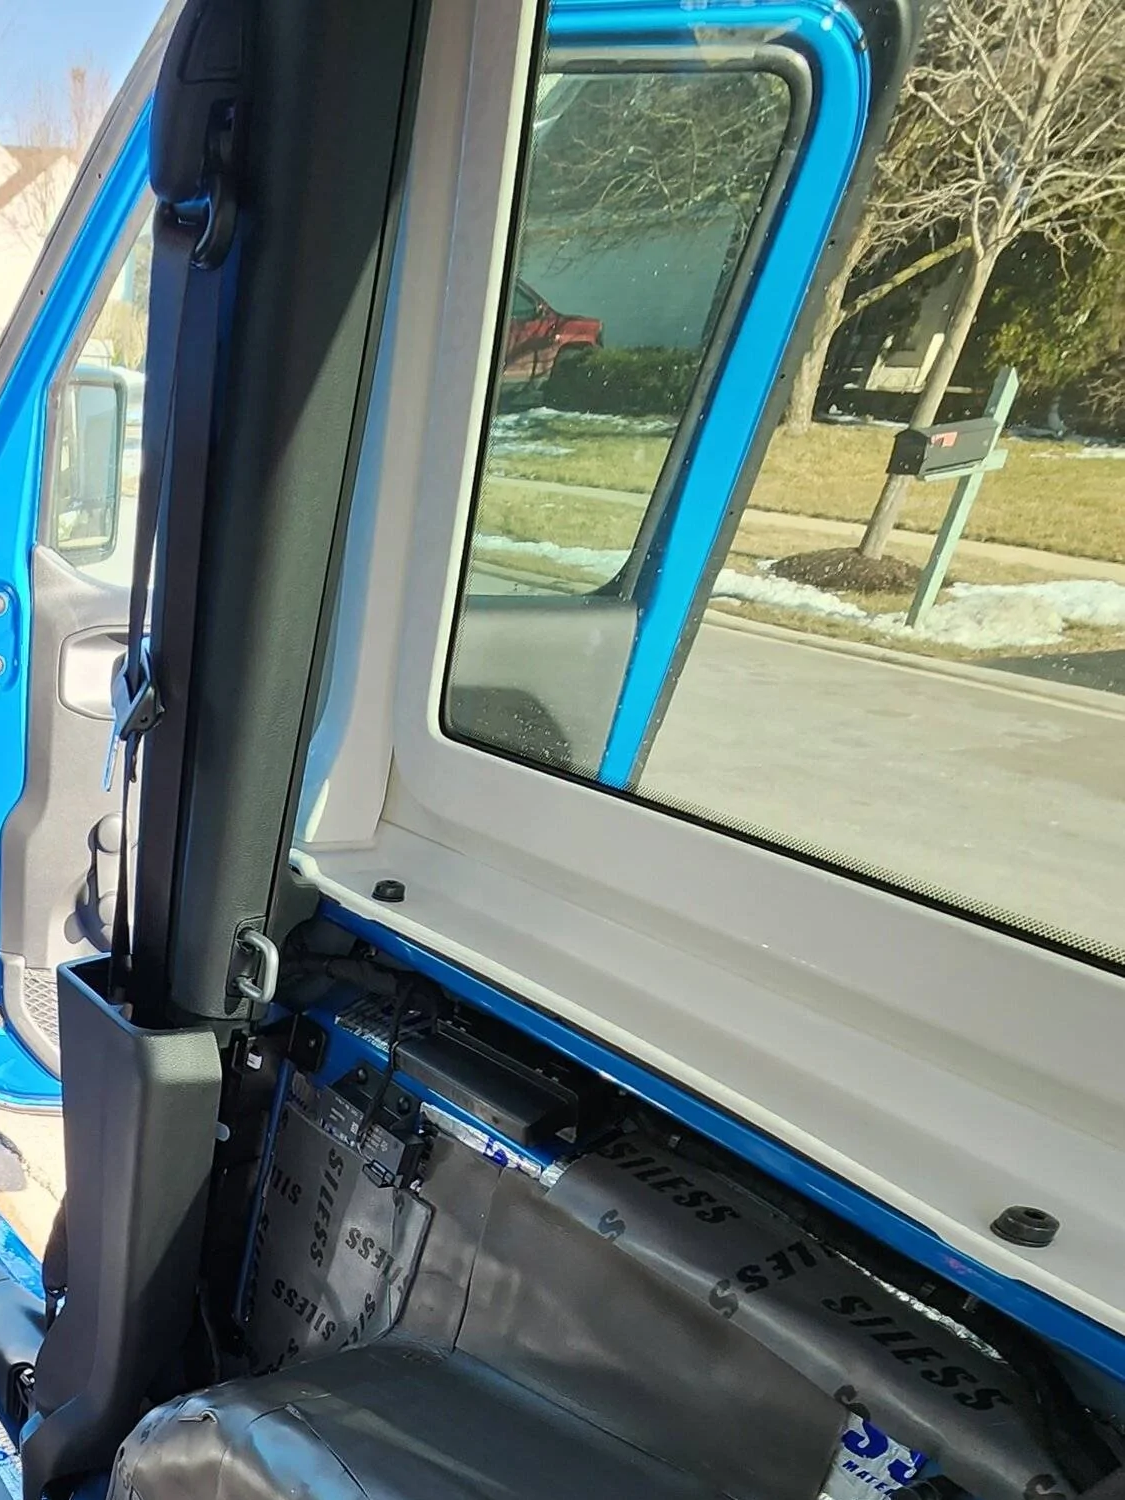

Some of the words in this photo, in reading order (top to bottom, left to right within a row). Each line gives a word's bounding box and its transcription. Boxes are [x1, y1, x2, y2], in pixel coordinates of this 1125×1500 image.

[310, 1147, 344, 1268] SILESS
[594, 1142, 742, 1225] SILESS
[271, 1277, 337, 1342] SILESS
[822, 1295, 1014, 1410] SILESS
